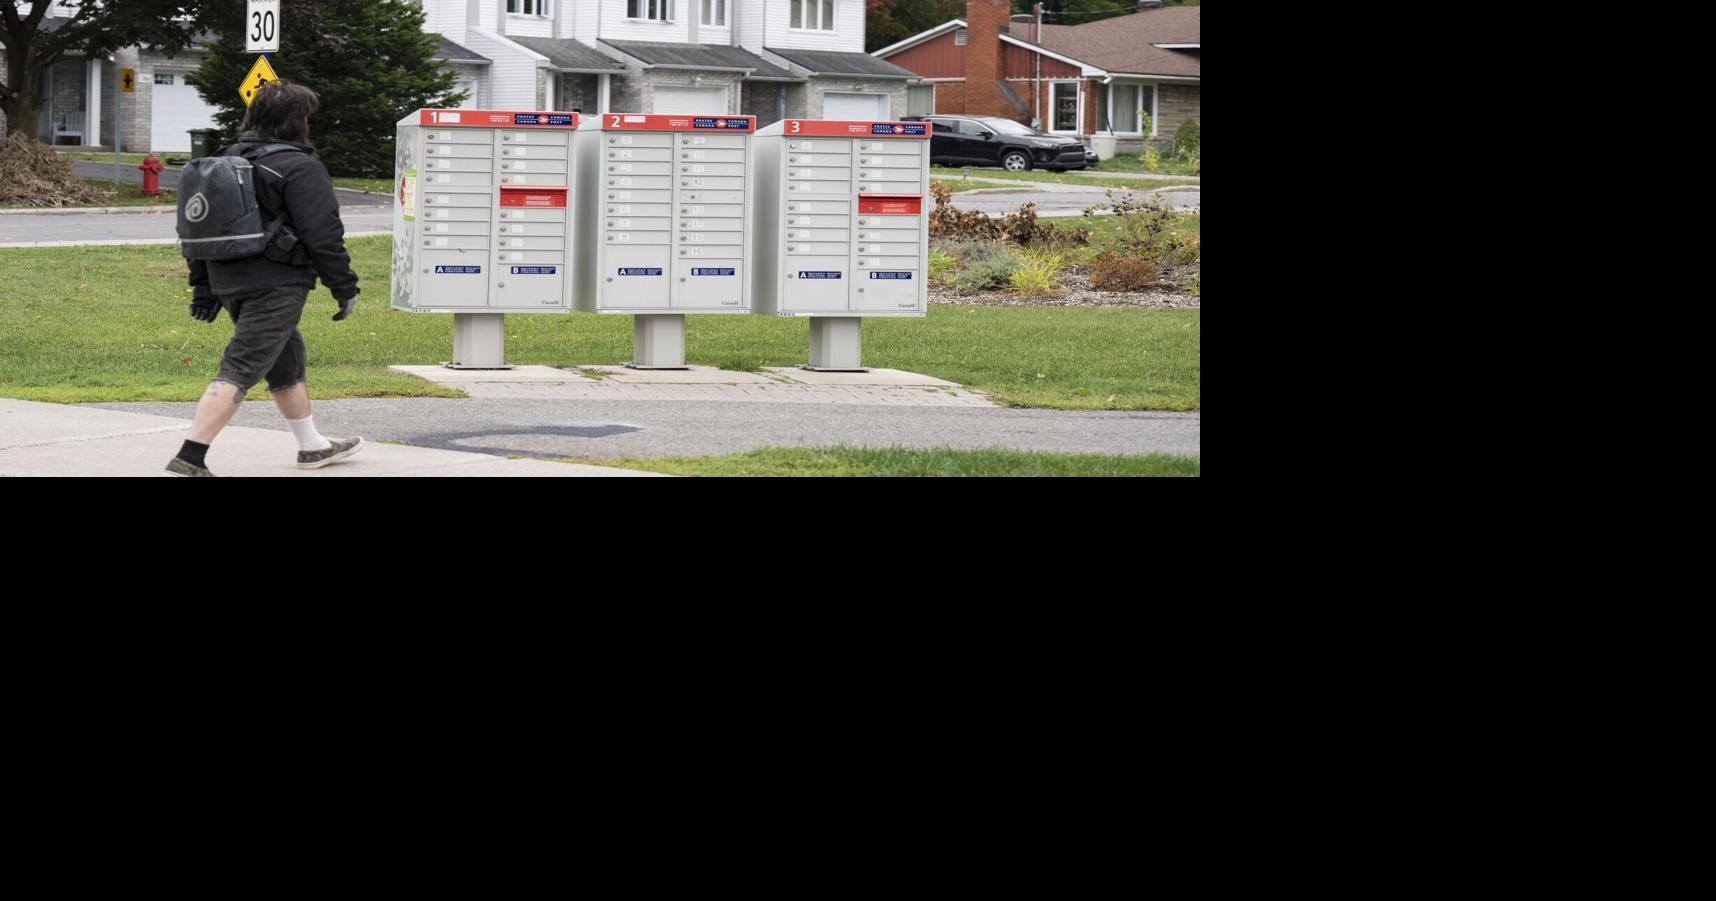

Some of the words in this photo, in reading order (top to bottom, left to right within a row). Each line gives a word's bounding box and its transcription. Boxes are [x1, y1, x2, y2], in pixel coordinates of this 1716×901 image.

[251, 10, 275, 42] 30
[430, 111, 437, 124] 1
[611, 115, 621, 128] 2
[791, 121, 800, 133] 3
[800, 271, 807, 279] A
